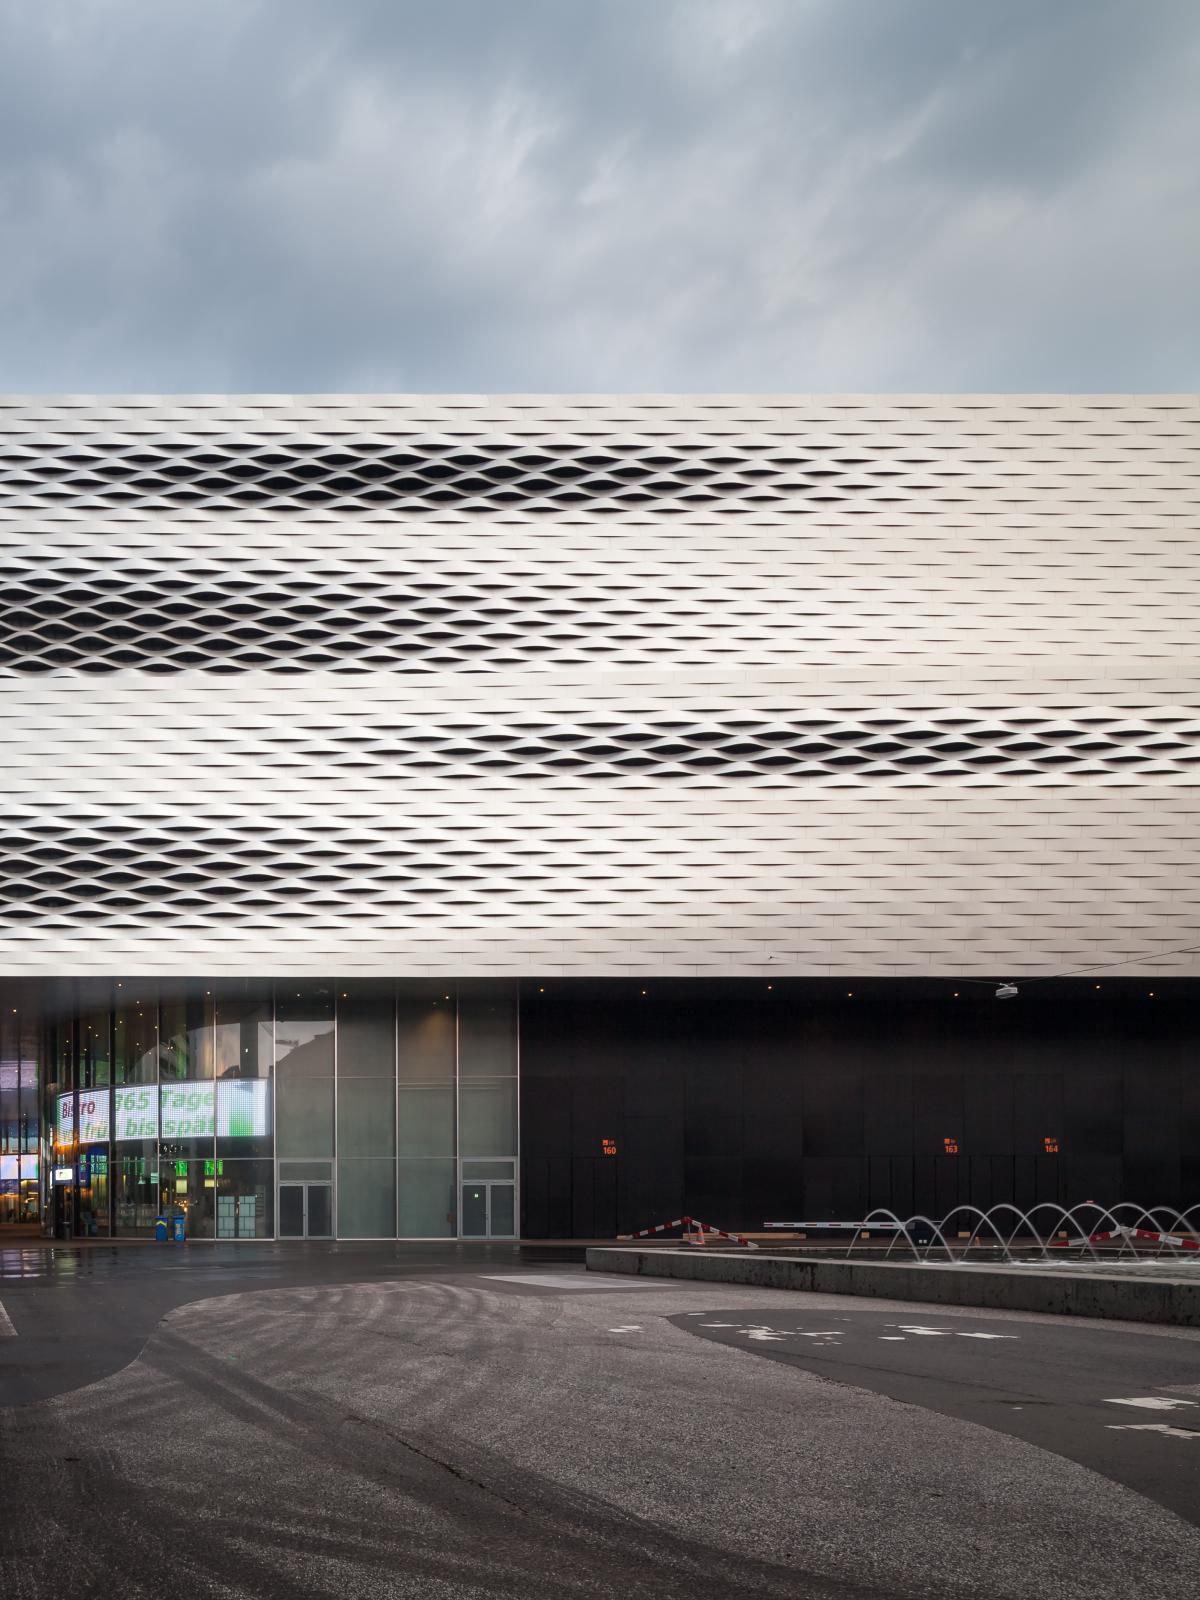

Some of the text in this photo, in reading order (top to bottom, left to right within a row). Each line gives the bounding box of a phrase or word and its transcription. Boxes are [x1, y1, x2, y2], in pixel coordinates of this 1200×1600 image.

[62, 1101, 96, 1119] Biro
[161, 1090, 215, 1112] Tage
[603, 1146, 617, 1155] 160
